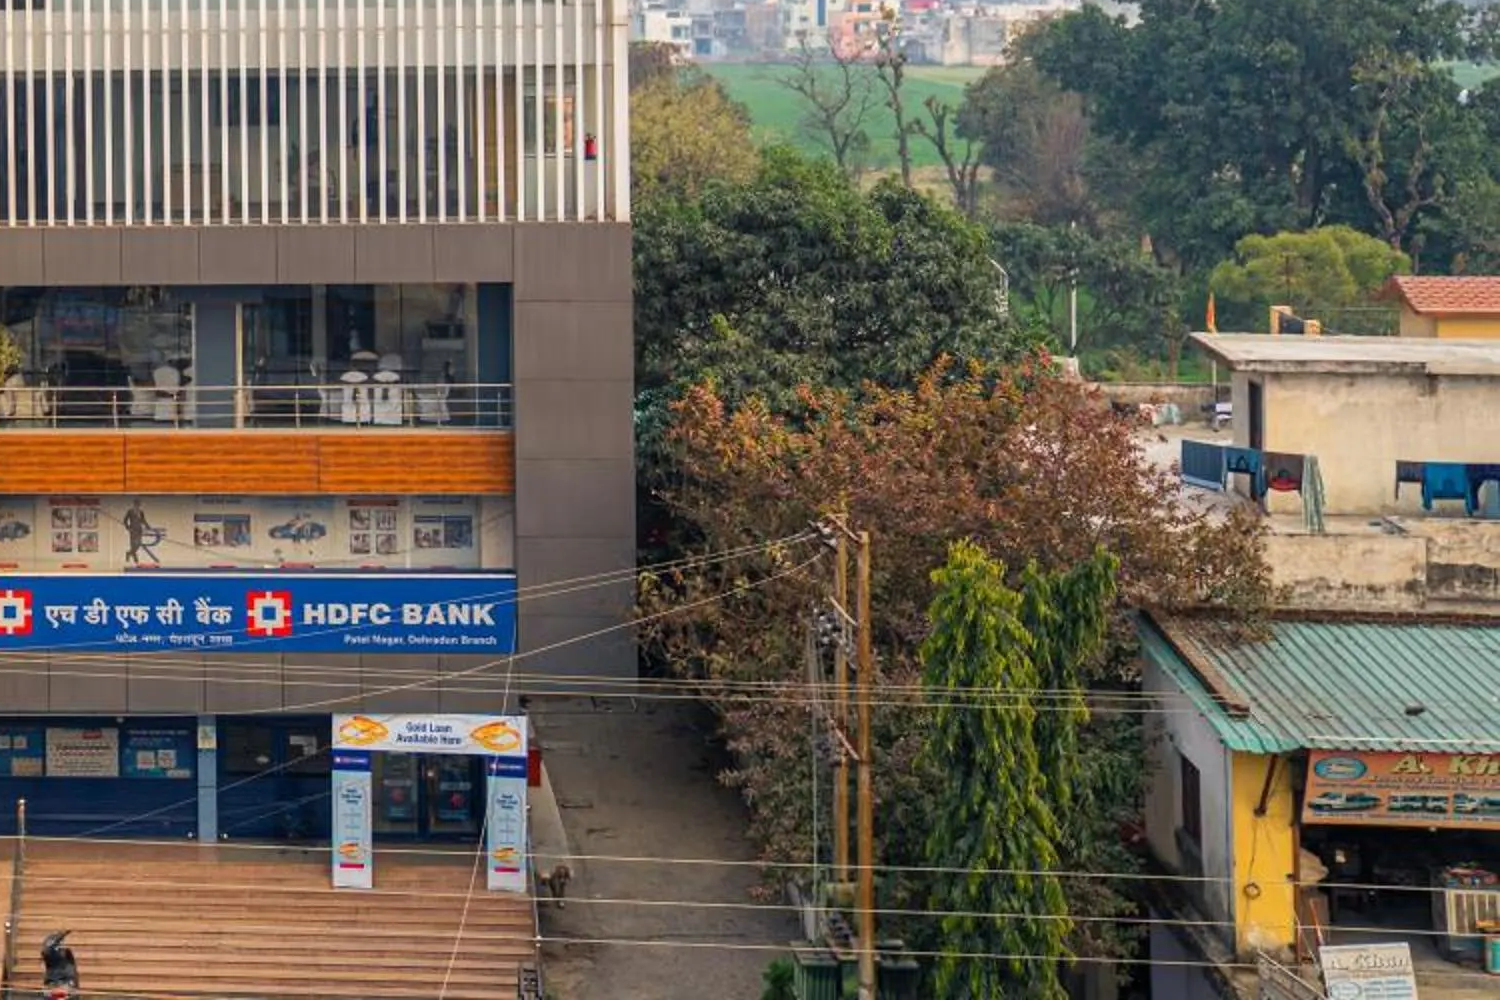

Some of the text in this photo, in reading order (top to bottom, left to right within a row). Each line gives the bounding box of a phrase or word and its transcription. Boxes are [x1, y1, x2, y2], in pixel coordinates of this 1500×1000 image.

[45, 596, 233, 629] एच डी एफ सी बैंक
[303, 603, 495, 625] HDFC BANK
[344, 634, 370, 644] Patel
[461, 635, 497, 646] Branch
[406, 721, 453, 733] Gold Loan
[395, 733, 439, 744] Available
